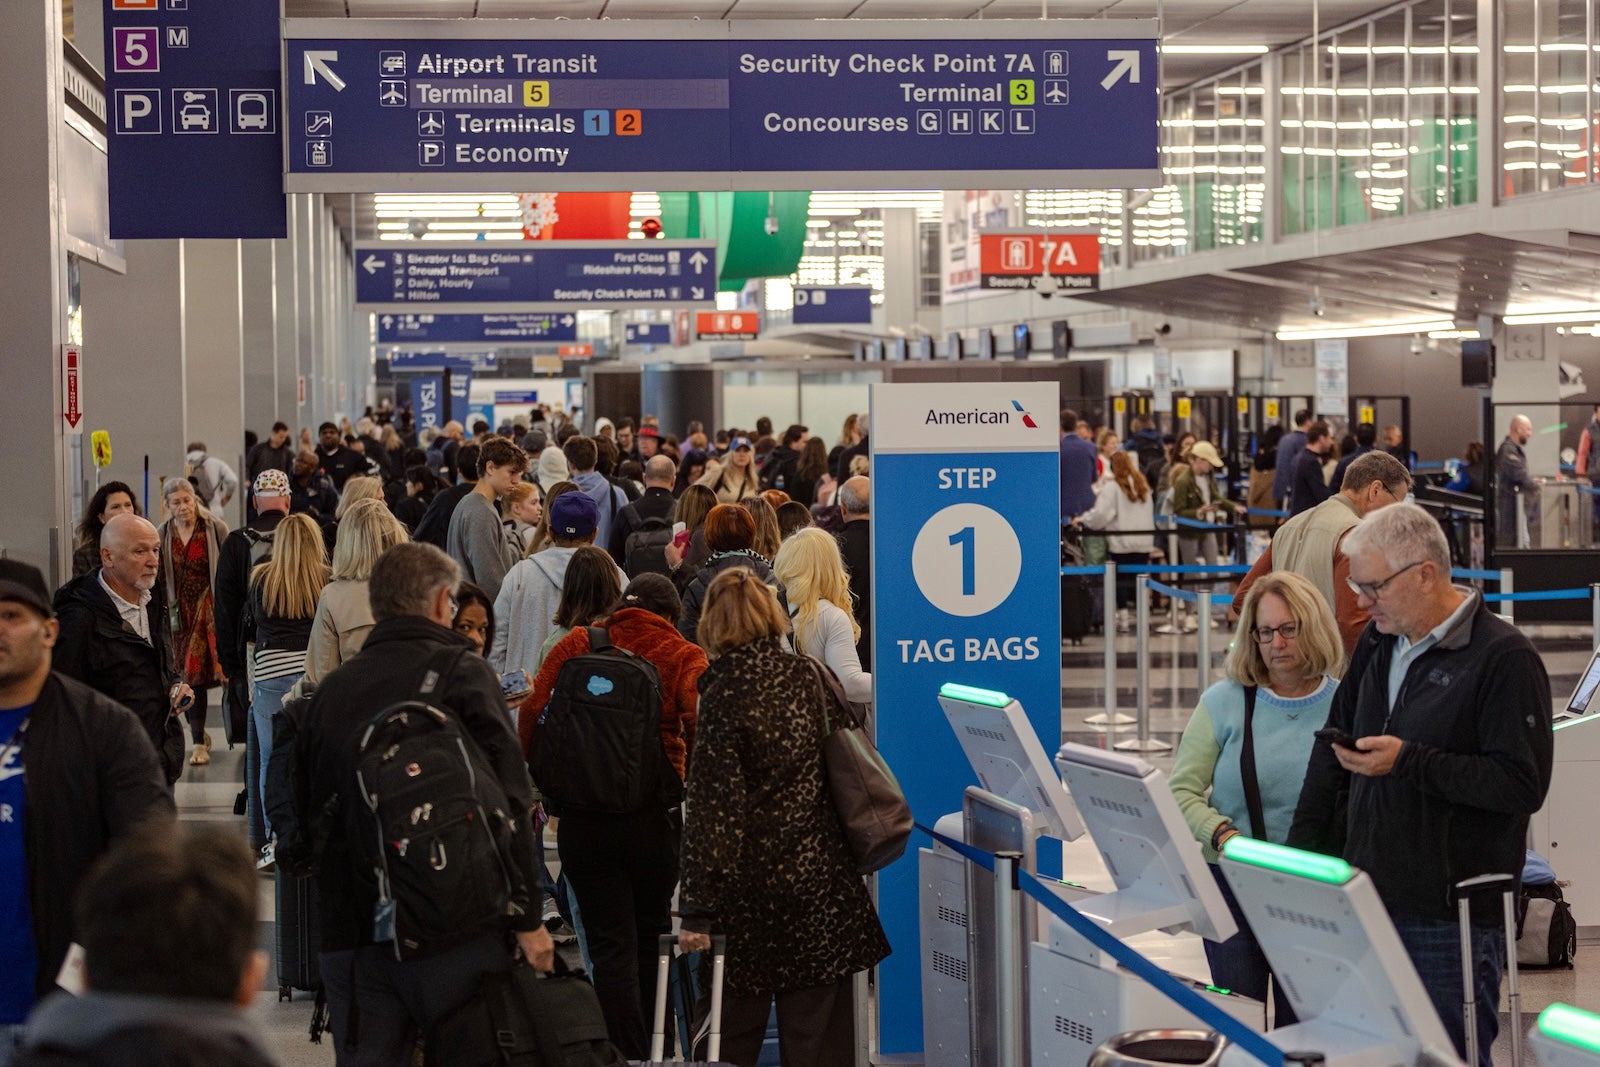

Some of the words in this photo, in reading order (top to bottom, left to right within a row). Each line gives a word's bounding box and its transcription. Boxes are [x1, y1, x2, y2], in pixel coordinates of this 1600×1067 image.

[169, 29, 187, 45] M
[125, 33, 148, 66] 5
[417, 54, 505, 77] Airport
[512, 54, 597, 73] Transit
[739, 53, 840, 77] Security
[848, 53, 925, 73] Check
[934, 54, 997, 73] Point
[1004, 54, 1036, 73] 7A
[416, 84, 513, 104] Terminal
[530, 85, 543, 103] 5
[900, 83, 1002, 102] Terminal
[1015, 84, 1029, 101] 3
[125, 95, 152, 129] P
[455, 113, 576, 133] Terminals
[592, 114, 600, 132] 1
[622, 114, 635, 132] 2
[763, 112, 909, 133] Concourses
[920, 113, 938, 132] G
[952, 113, 969, 131] H
[983, 113, 1000, 131] K
[1016, 113, 1029, 131] L
[424, 145, 439, 162] P
[455, 143, 569, 167] Economy
[407, 254, 449, 263] Elevator
[468, 254, 488, 265] Bag
[490, 254, 520, 263] Claim
[614, 253, 636, 262] First
[638, 253, 665, 262] Class
[1039, 241, 1078, 266] 7A
[408, 266, 447, 276] Ground
[449, 266, 499, 277] Transport
[583, 265, 631, 275] Rideshare
[633, 265, 666, 276] Pickup
[408, 279, 437, 289] Daily,
[439, 279, 474, 289] Hourly
[988, 276, 1030, 289] Security
[1065, 276, 1093, 287] Point
[408, 290, 440, 300] Hilton
[553, 289, 594, 300] Security
[595, 289, 624, 299] Check
[626, 289, 651, 299] Point
[653, 289, 667, 299] 7A
[794, 291, 808, 306] D
[420, 380, 437, 411] TSA
[925, 409, 1010, 425] American
[938, 468, 997, 490] STEP
[948, 526, 976, 596] 1
[897, 639, 955, 664] TAG
[964, 637, 1040, 662] BAGS
